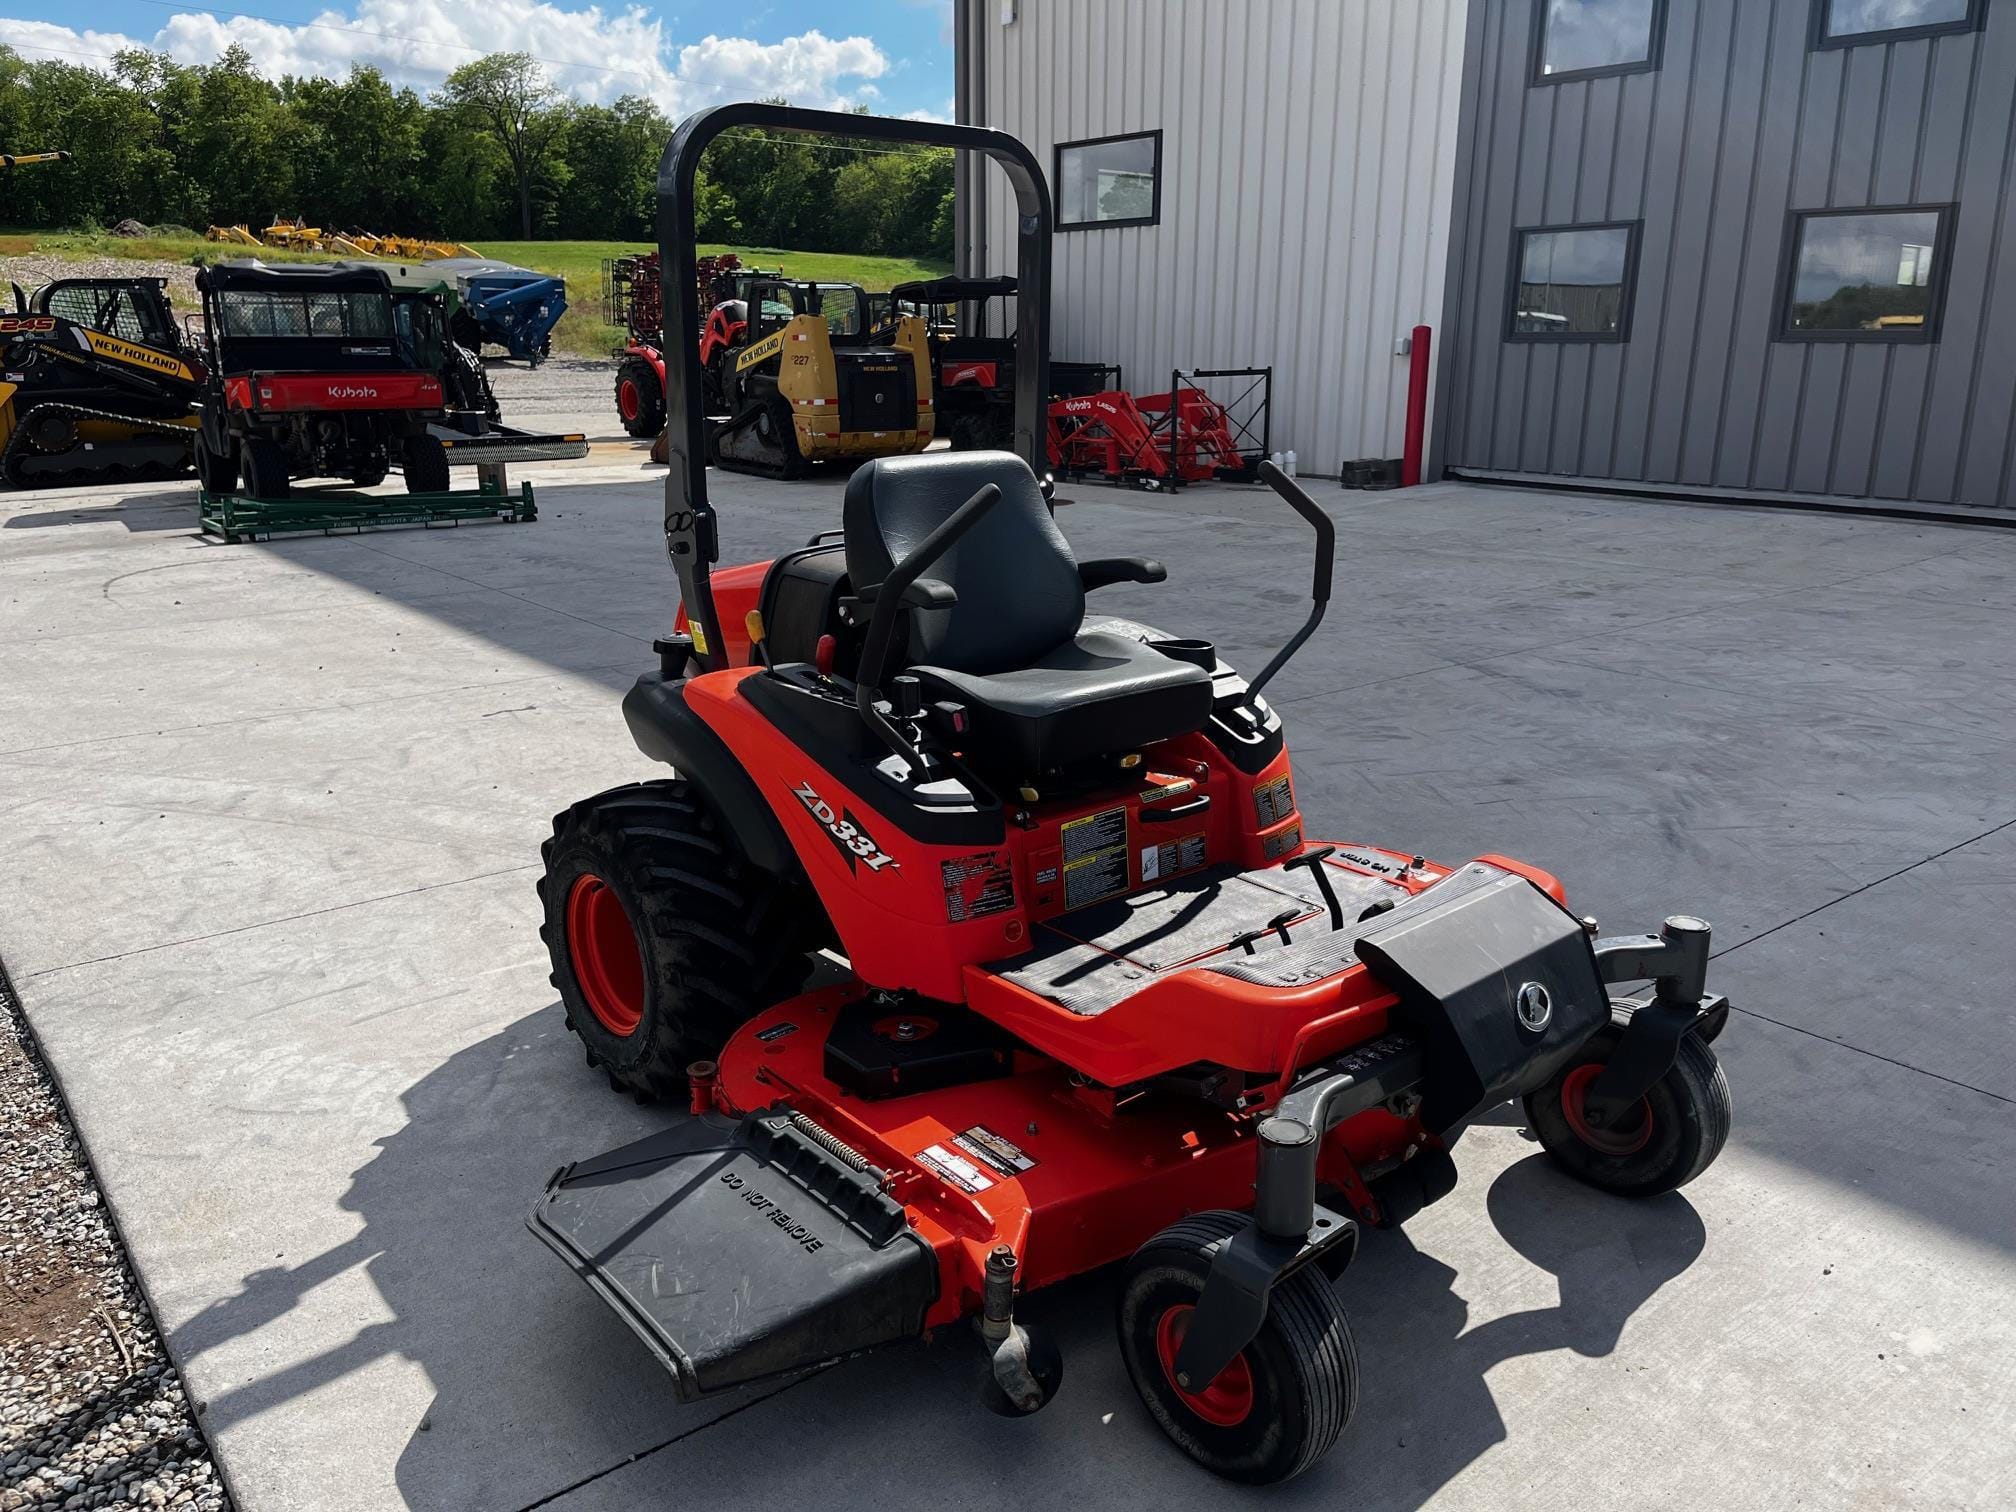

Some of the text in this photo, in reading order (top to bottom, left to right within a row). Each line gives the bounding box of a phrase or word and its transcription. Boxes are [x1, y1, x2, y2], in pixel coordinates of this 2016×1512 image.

[94, 338, 123, 356] NEW
[124, 348, 178, 371] HOLLAND
[740, 338, 779, 365] NEW HOLLAND
[328, 385, 378, 399] Kubota
[1065, 400, 1092, 411] Kubota
[792, 780, 894, 872] ZD331
[720, 1172, 825, 1254] DO NOT REMOVE
